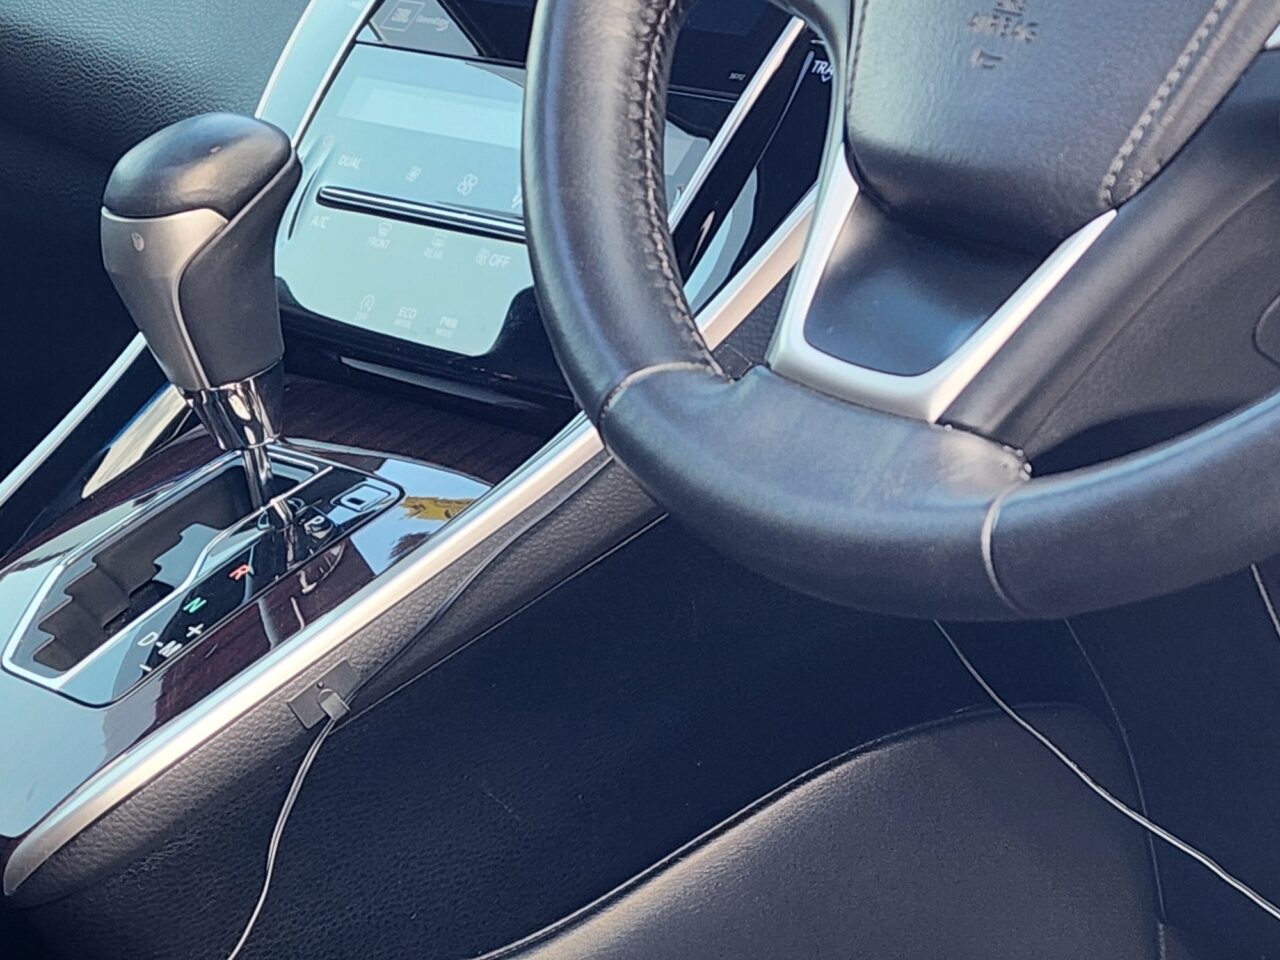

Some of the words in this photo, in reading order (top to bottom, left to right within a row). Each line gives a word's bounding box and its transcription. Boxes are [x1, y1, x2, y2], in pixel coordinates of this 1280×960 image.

[338, 154, 362, 170] DUAL
[310, 215, 330, 229] A/C
[489, 253, 512, 268] OFF
[399, 306, 418, 319] ECO
[229, 564, 251, 580] R
[183, 597, 207, 613] N
